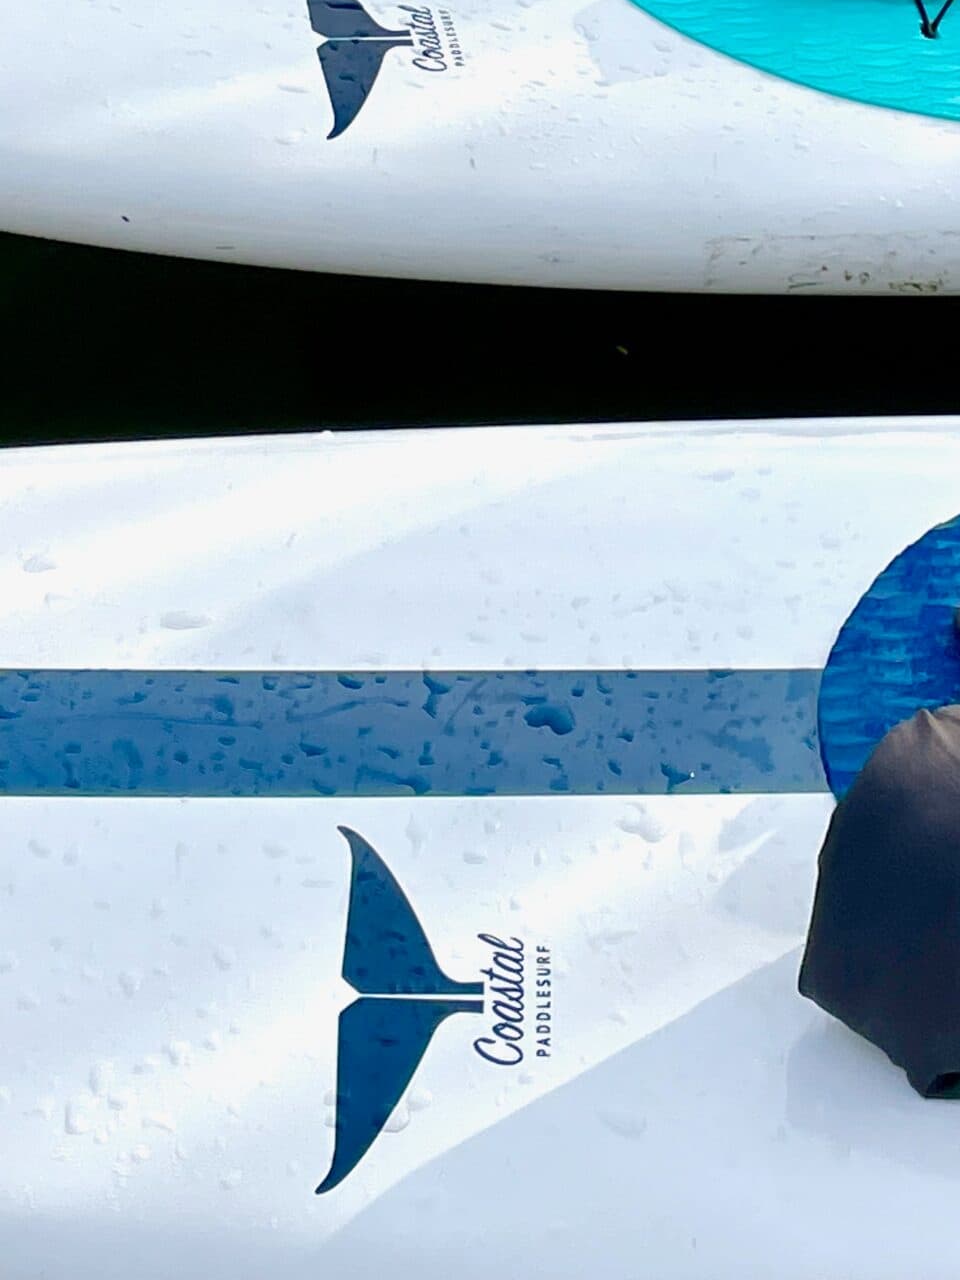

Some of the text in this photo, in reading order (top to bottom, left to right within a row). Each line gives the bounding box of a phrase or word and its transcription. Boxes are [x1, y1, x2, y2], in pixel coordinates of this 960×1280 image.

[396, 4, 448, 72] Coastal
[473, 933, 525, 1066] Coastal
[536, 945, 552, 1058] PADDLESURF
